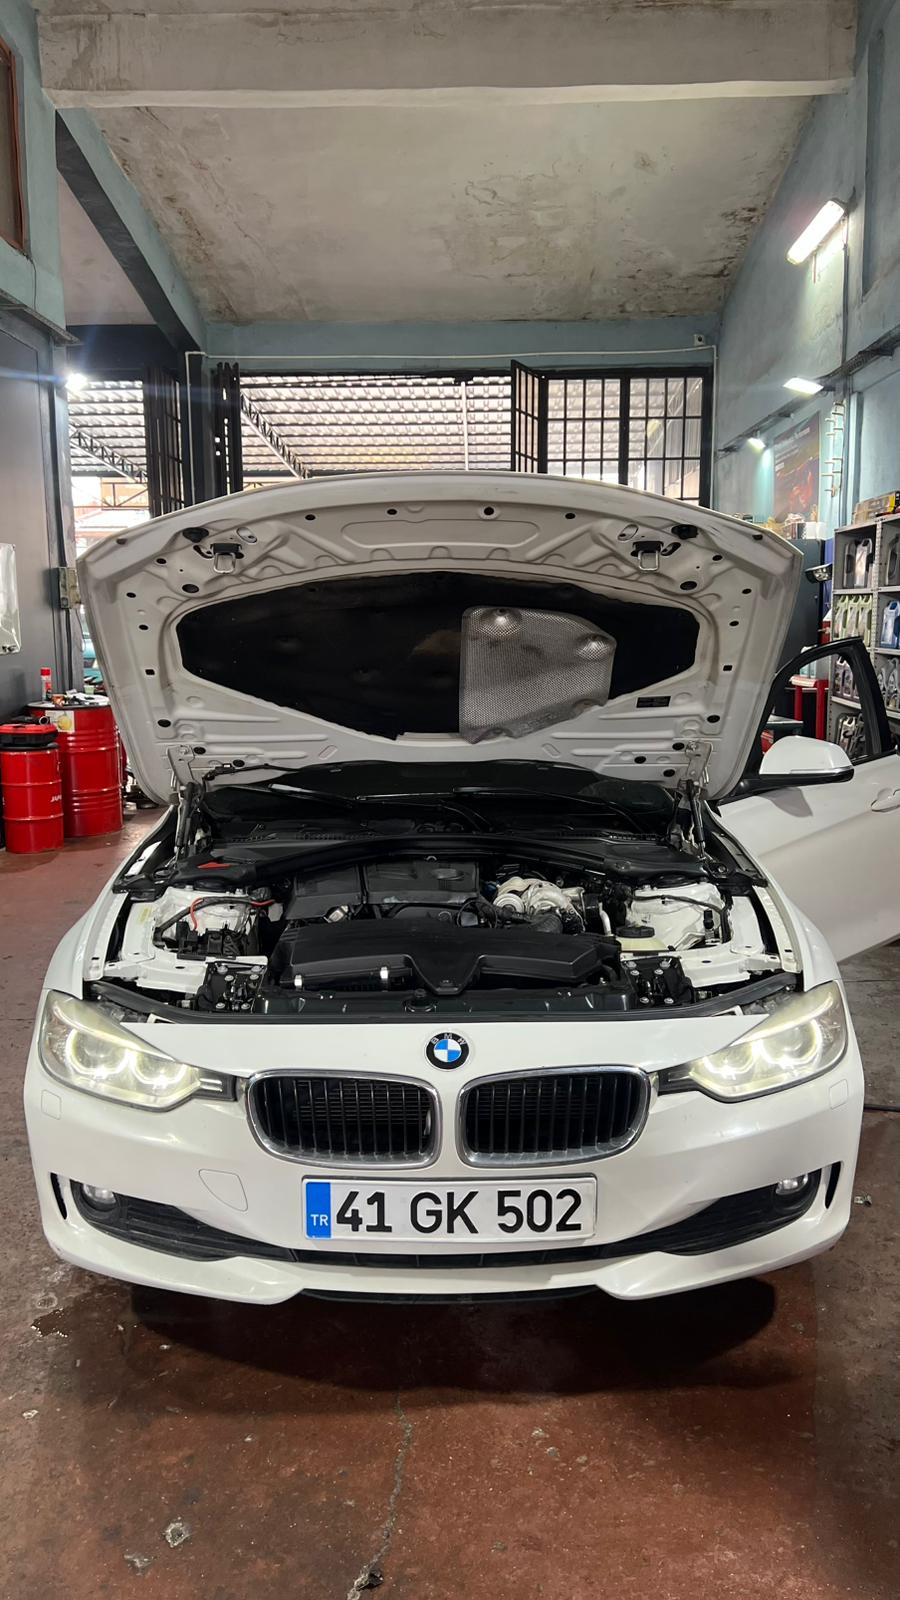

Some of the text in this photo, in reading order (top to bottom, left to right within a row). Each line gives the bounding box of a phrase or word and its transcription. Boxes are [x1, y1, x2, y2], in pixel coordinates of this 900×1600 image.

[431, 1033, 467, 1046] BMW
[336, 1189, 582, 1234] 41 GK 502
[310, 1214, 329, 1226] TR
